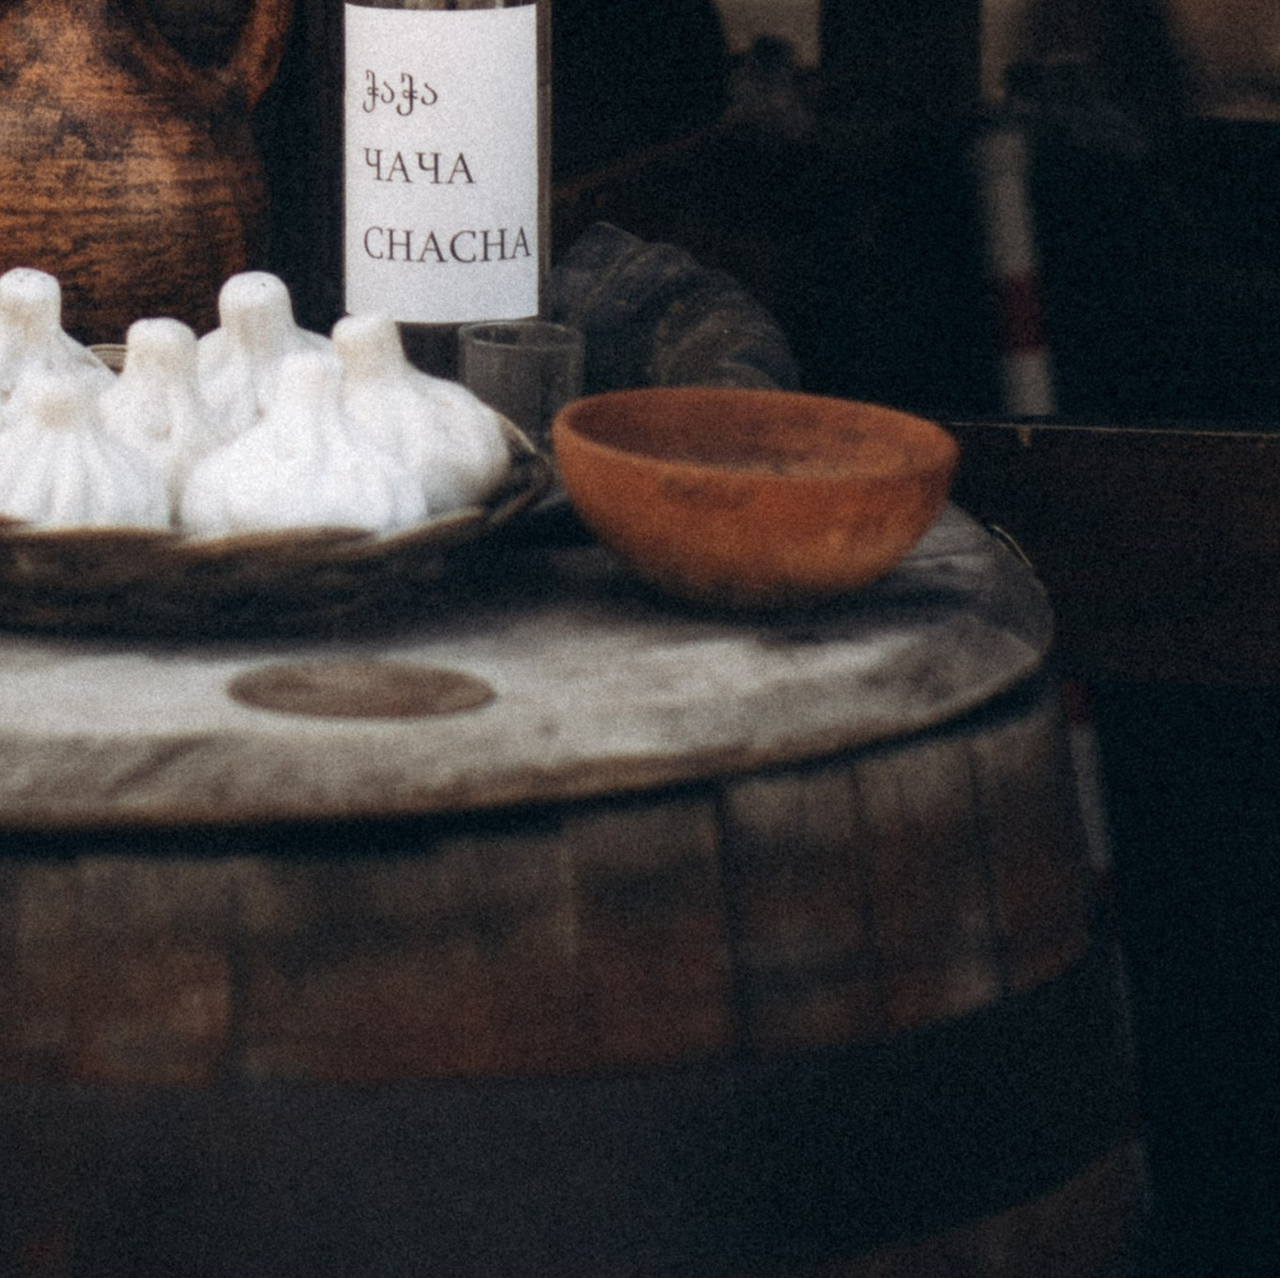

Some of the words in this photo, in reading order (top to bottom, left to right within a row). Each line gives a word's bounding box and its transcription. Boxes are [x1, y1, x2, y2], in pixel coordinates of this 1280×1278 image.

[362, 69, 438, 116] ჭაჭა
[363, 147, 476, 185] ЧАЧА
[363, 225, 532, 264] CHACHA
